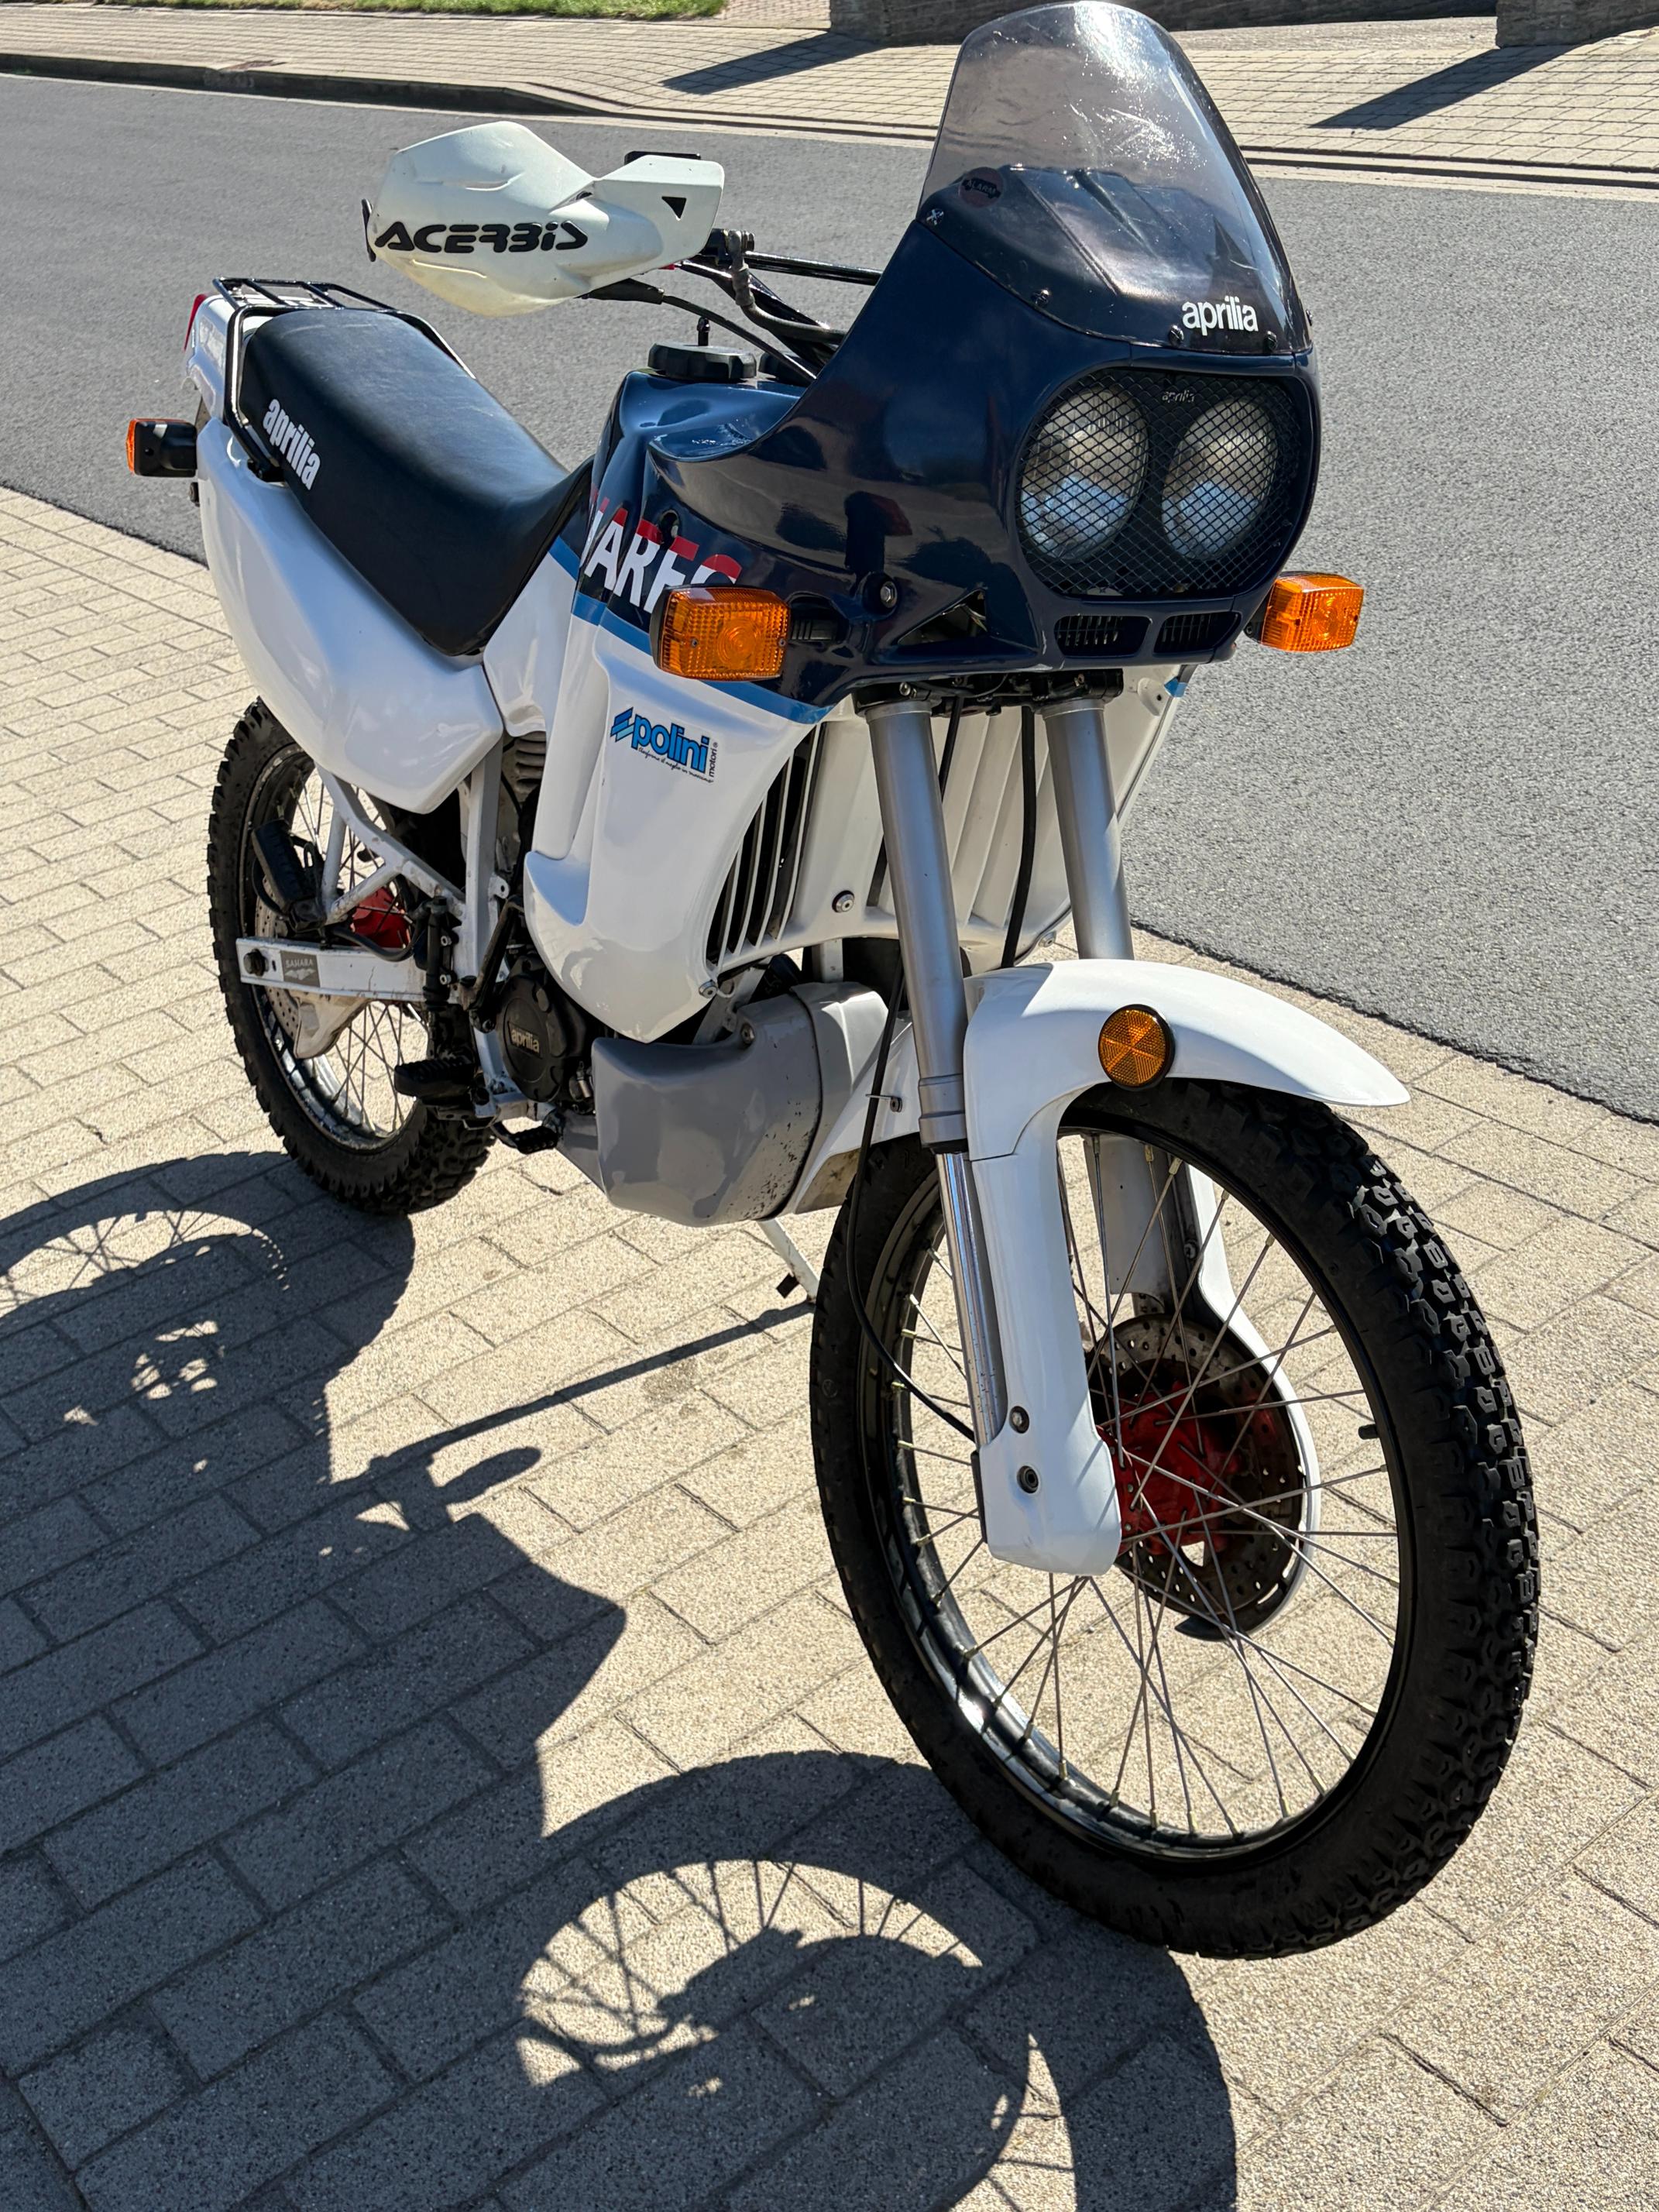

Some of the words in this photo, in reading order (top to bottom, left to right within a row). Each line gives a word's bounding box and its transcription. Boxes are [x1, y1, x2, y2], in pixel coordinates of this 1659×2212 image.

[1181, 295, 1259, 336] aprilia
[263, 398, 321, 490] aprilia
[630, 713, 710, 774] polini
[285, 958, 314, 968] SAHARA
[511, 1029, 540, 1054] aprilia
